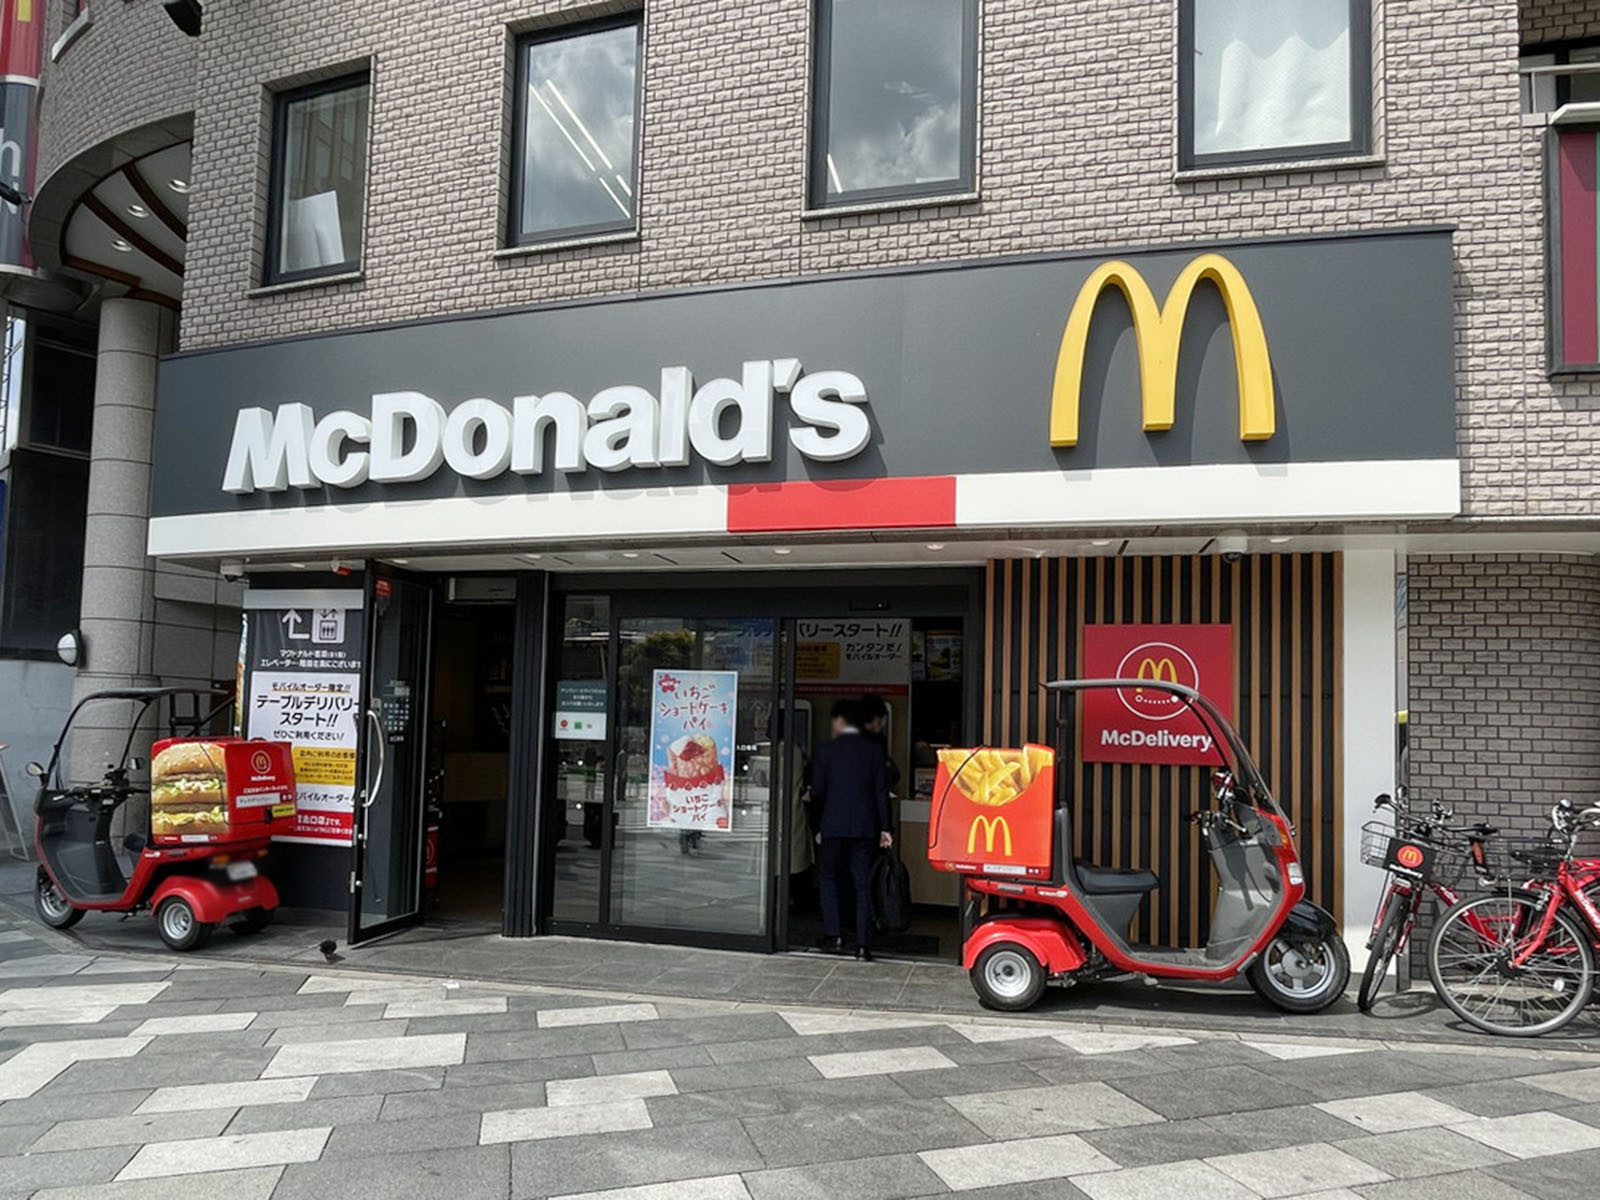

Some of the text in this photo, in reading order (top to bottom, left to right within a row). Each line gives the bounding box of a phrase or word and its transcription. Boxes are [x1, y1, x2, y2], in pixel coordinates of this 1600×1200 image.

[222, 358, 870, 495] McDonald's
[674, 685, 716, 700] いちご
[660, 702, 727, 717] ショートケーキ
[280, 712, 338, 727] スタート!!
[683, 716, 706, 730] パイ
[1101, 730, 1212, 752] McDelivery
[296, 791, 350, 803] バイルオーダー
